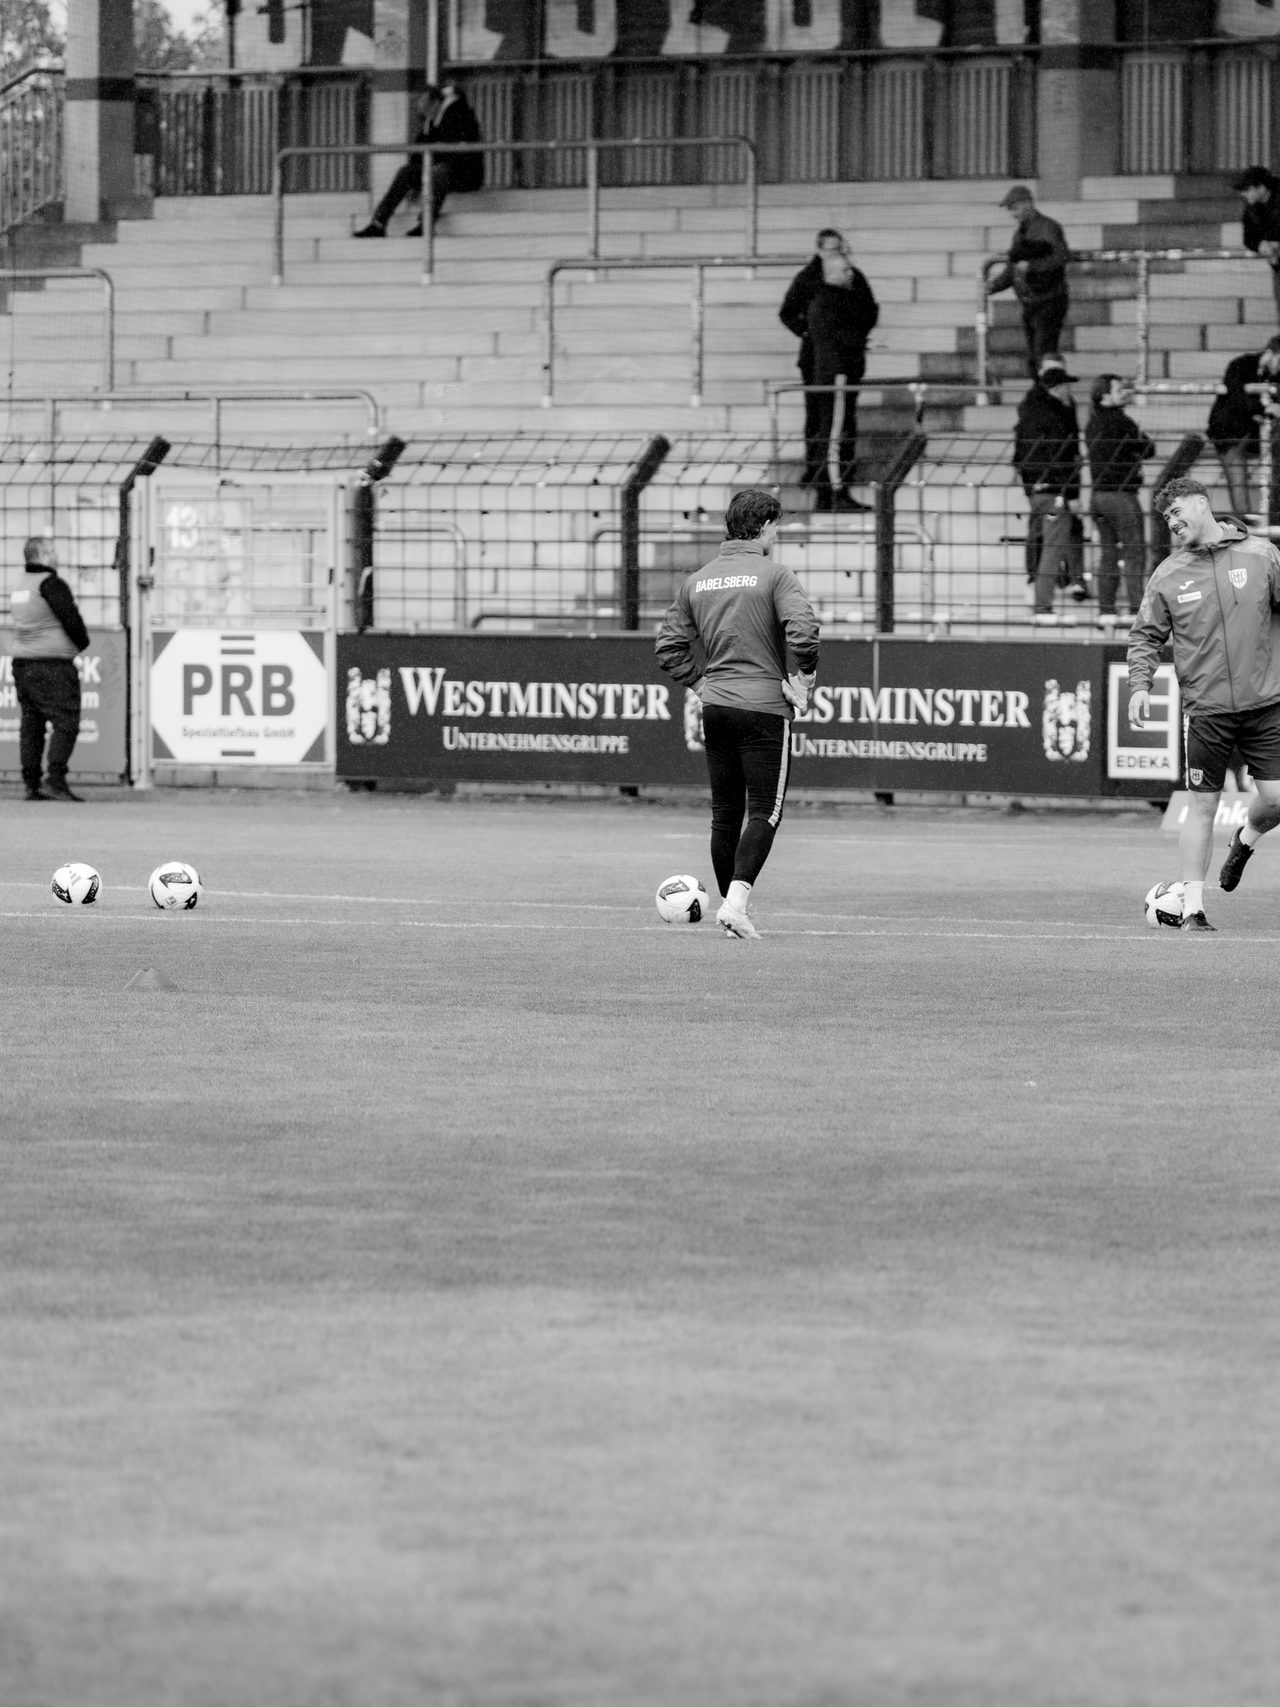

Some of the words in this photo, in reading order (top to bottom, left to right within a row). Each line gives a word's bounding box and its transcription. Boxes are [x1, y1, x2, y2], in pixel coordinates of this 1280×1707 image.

[695, 575, 758, 593] BABELSBERG
[183, 664, 295, 716] PRB
[793, 686, 1032, 728] STMINSTER
[1116, 755, 1171, 769] EDEKA
